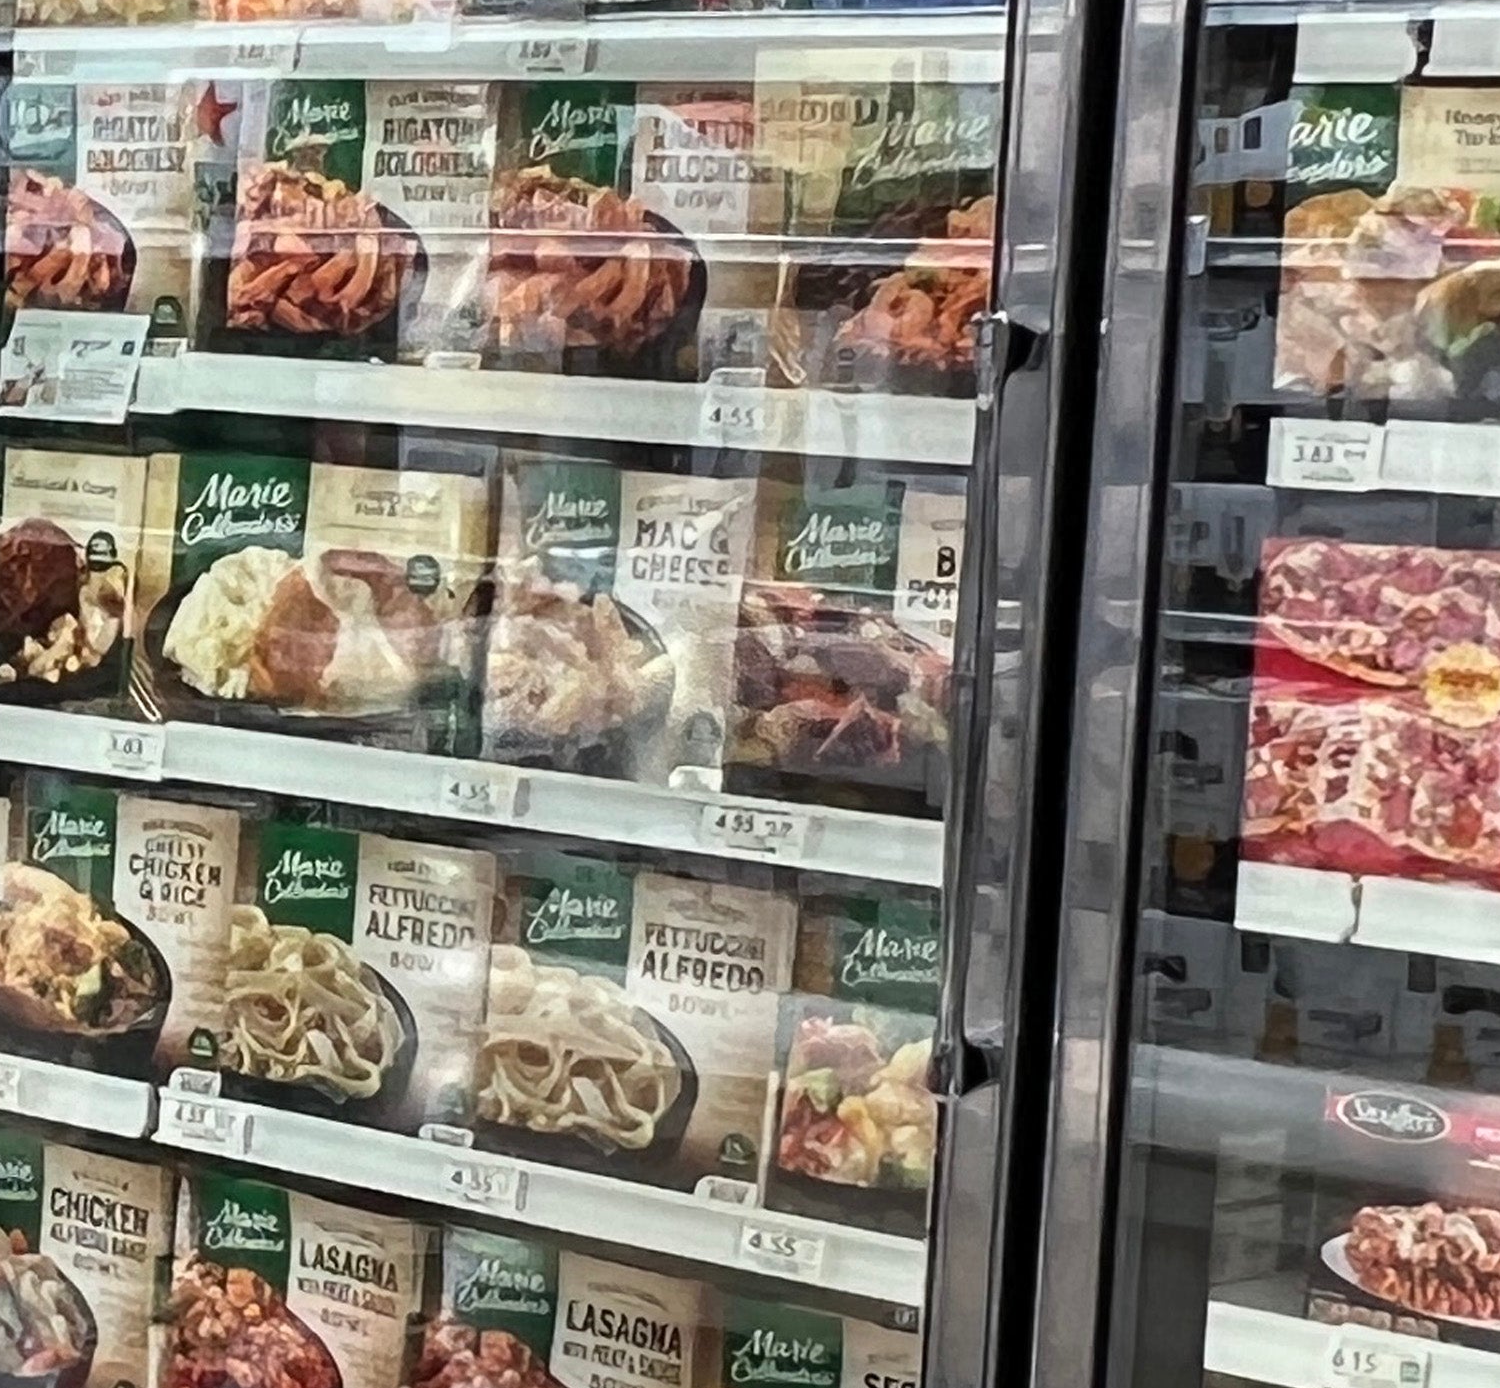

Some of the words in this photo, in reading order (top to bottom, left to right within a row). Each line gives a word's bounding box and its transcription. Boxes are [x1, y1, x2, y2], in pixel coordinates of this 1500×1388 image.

[1286, 107, 1380, 150] arie
[185, 472, 296, 512] Marie
[788, 512, 886, 548] Marie
[564, 1299, 683, 1359] LASAGNA
